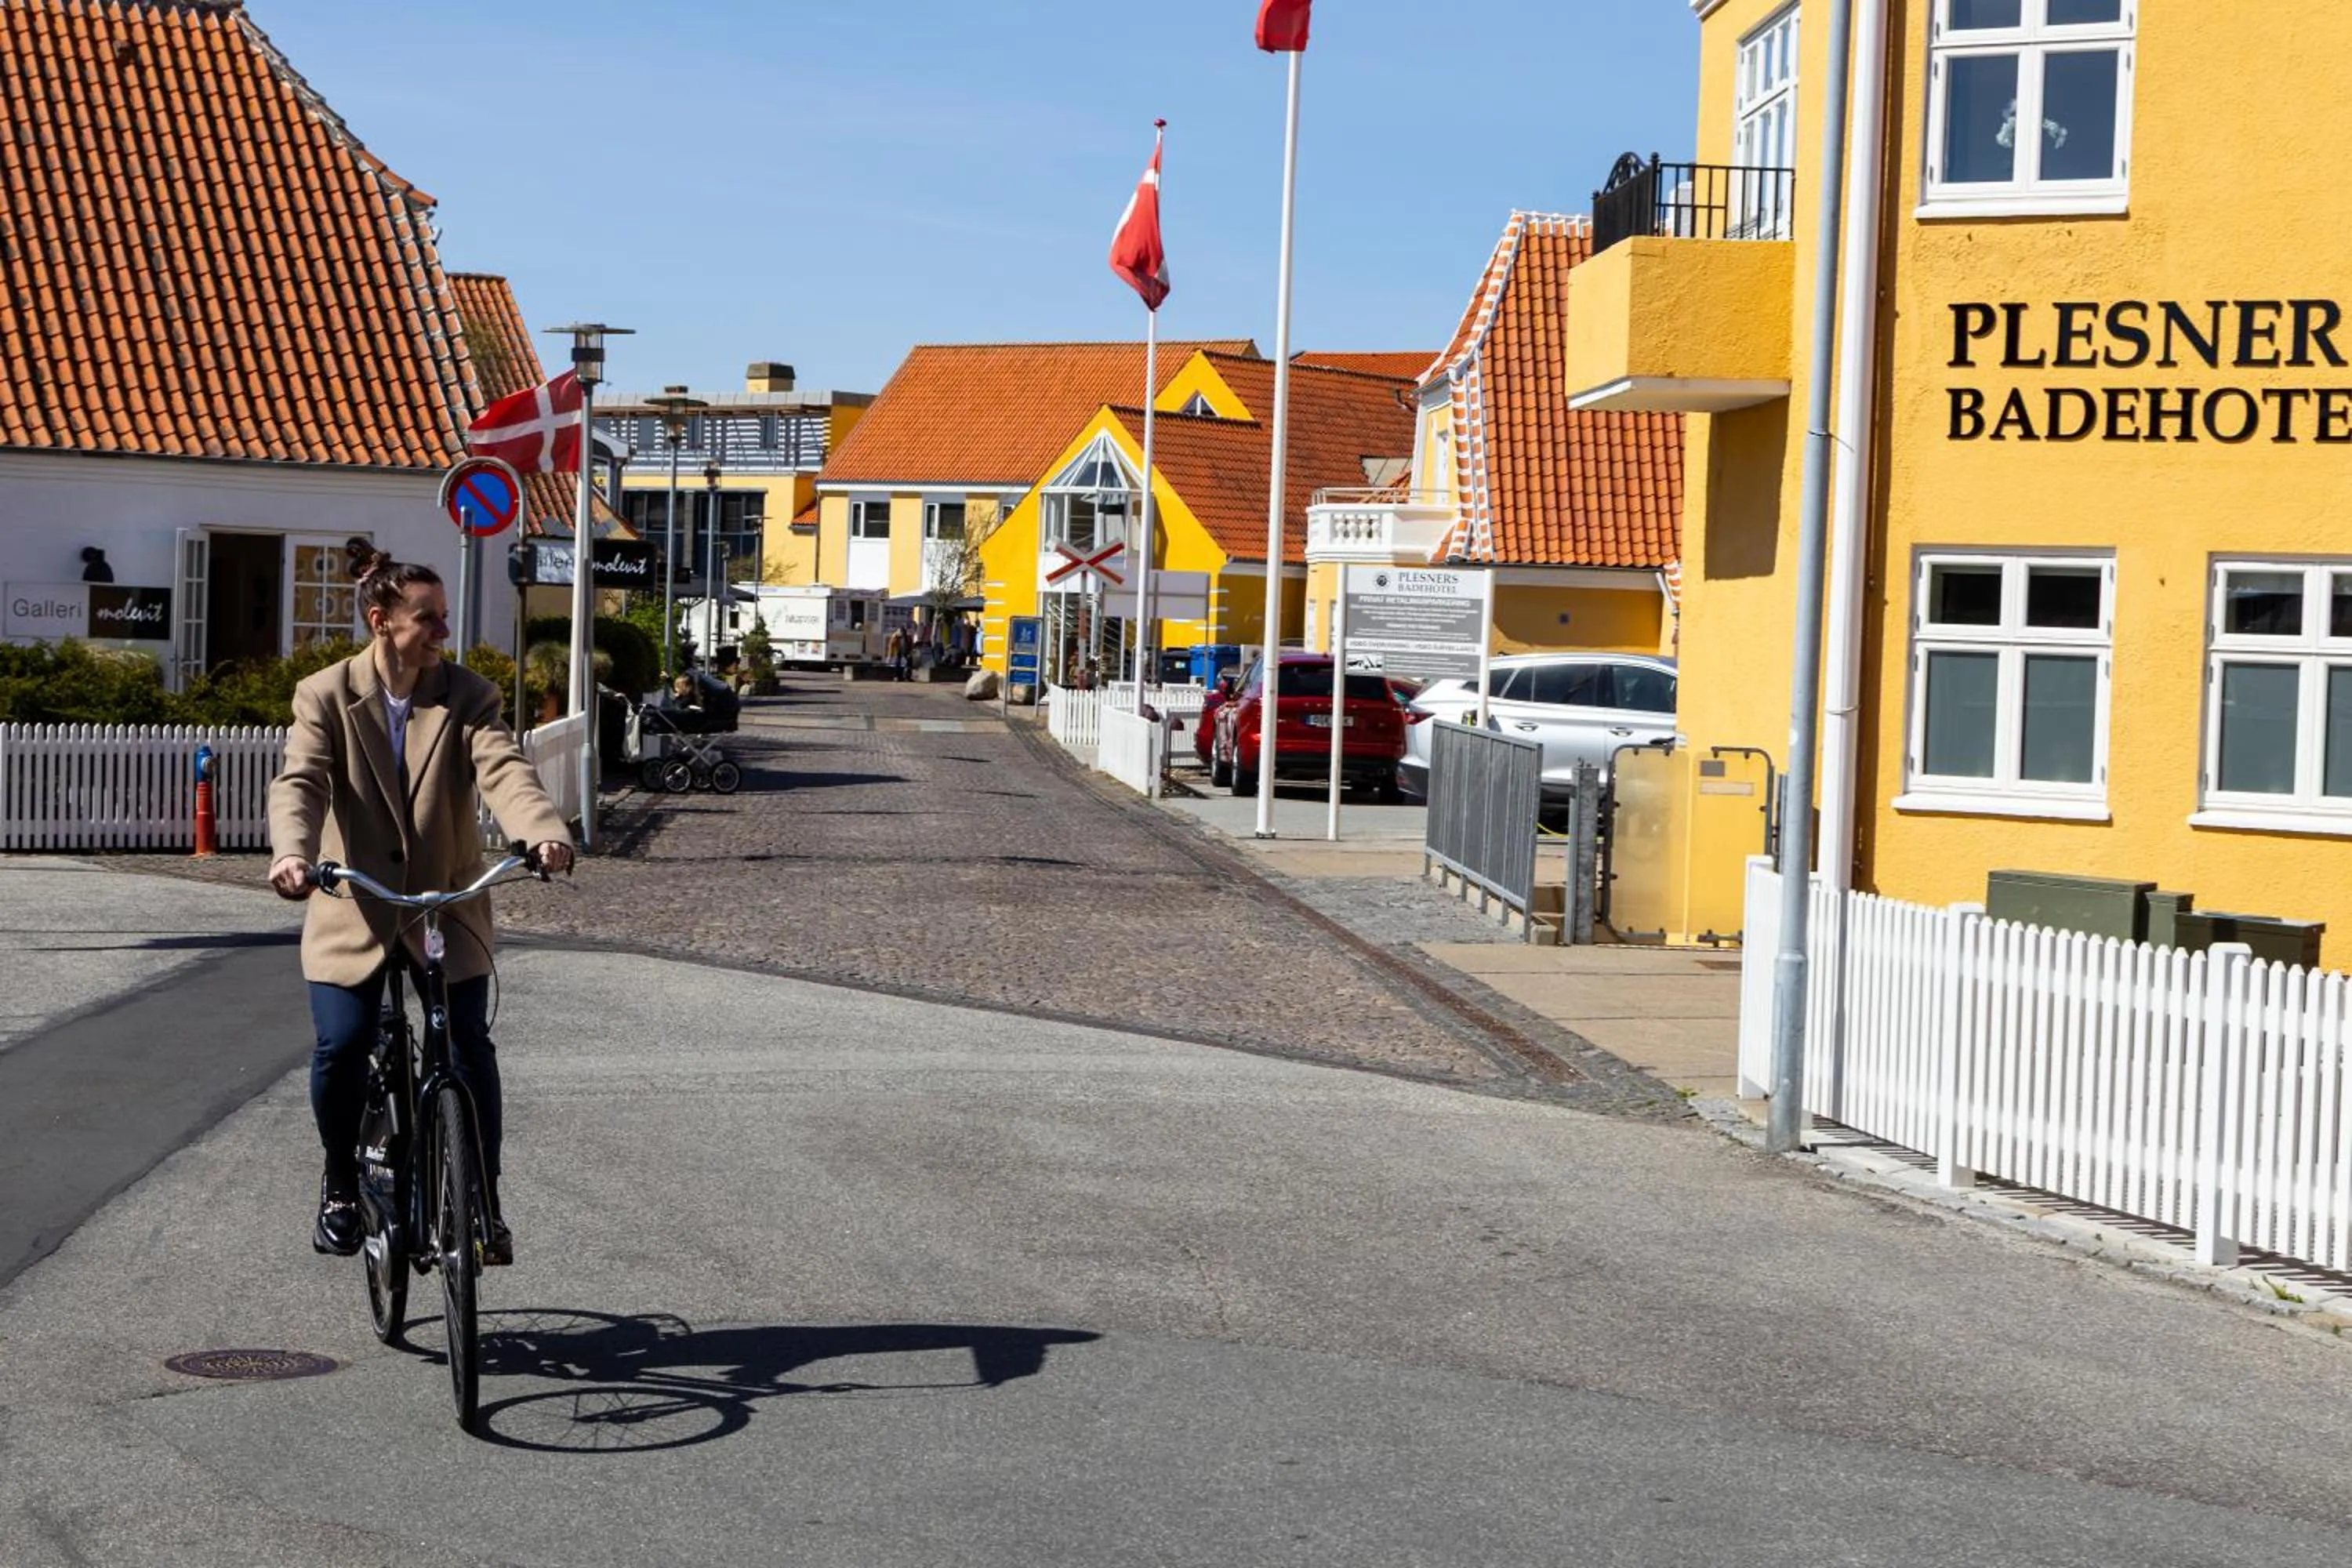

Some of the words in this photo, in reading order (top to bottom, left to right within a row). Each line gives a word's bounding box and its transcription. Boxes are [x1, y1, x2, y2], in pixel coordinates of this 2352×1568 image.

[1947, 299, 2349, 368] PLESNER
[1945, 387, 2352, 444] BADEHOTE
[1398, 583, 1457, 593] BADEHOTEL
[1399, 572, 1459, 584] PLESNERS
[12, 597, 82, 619] Galleri
